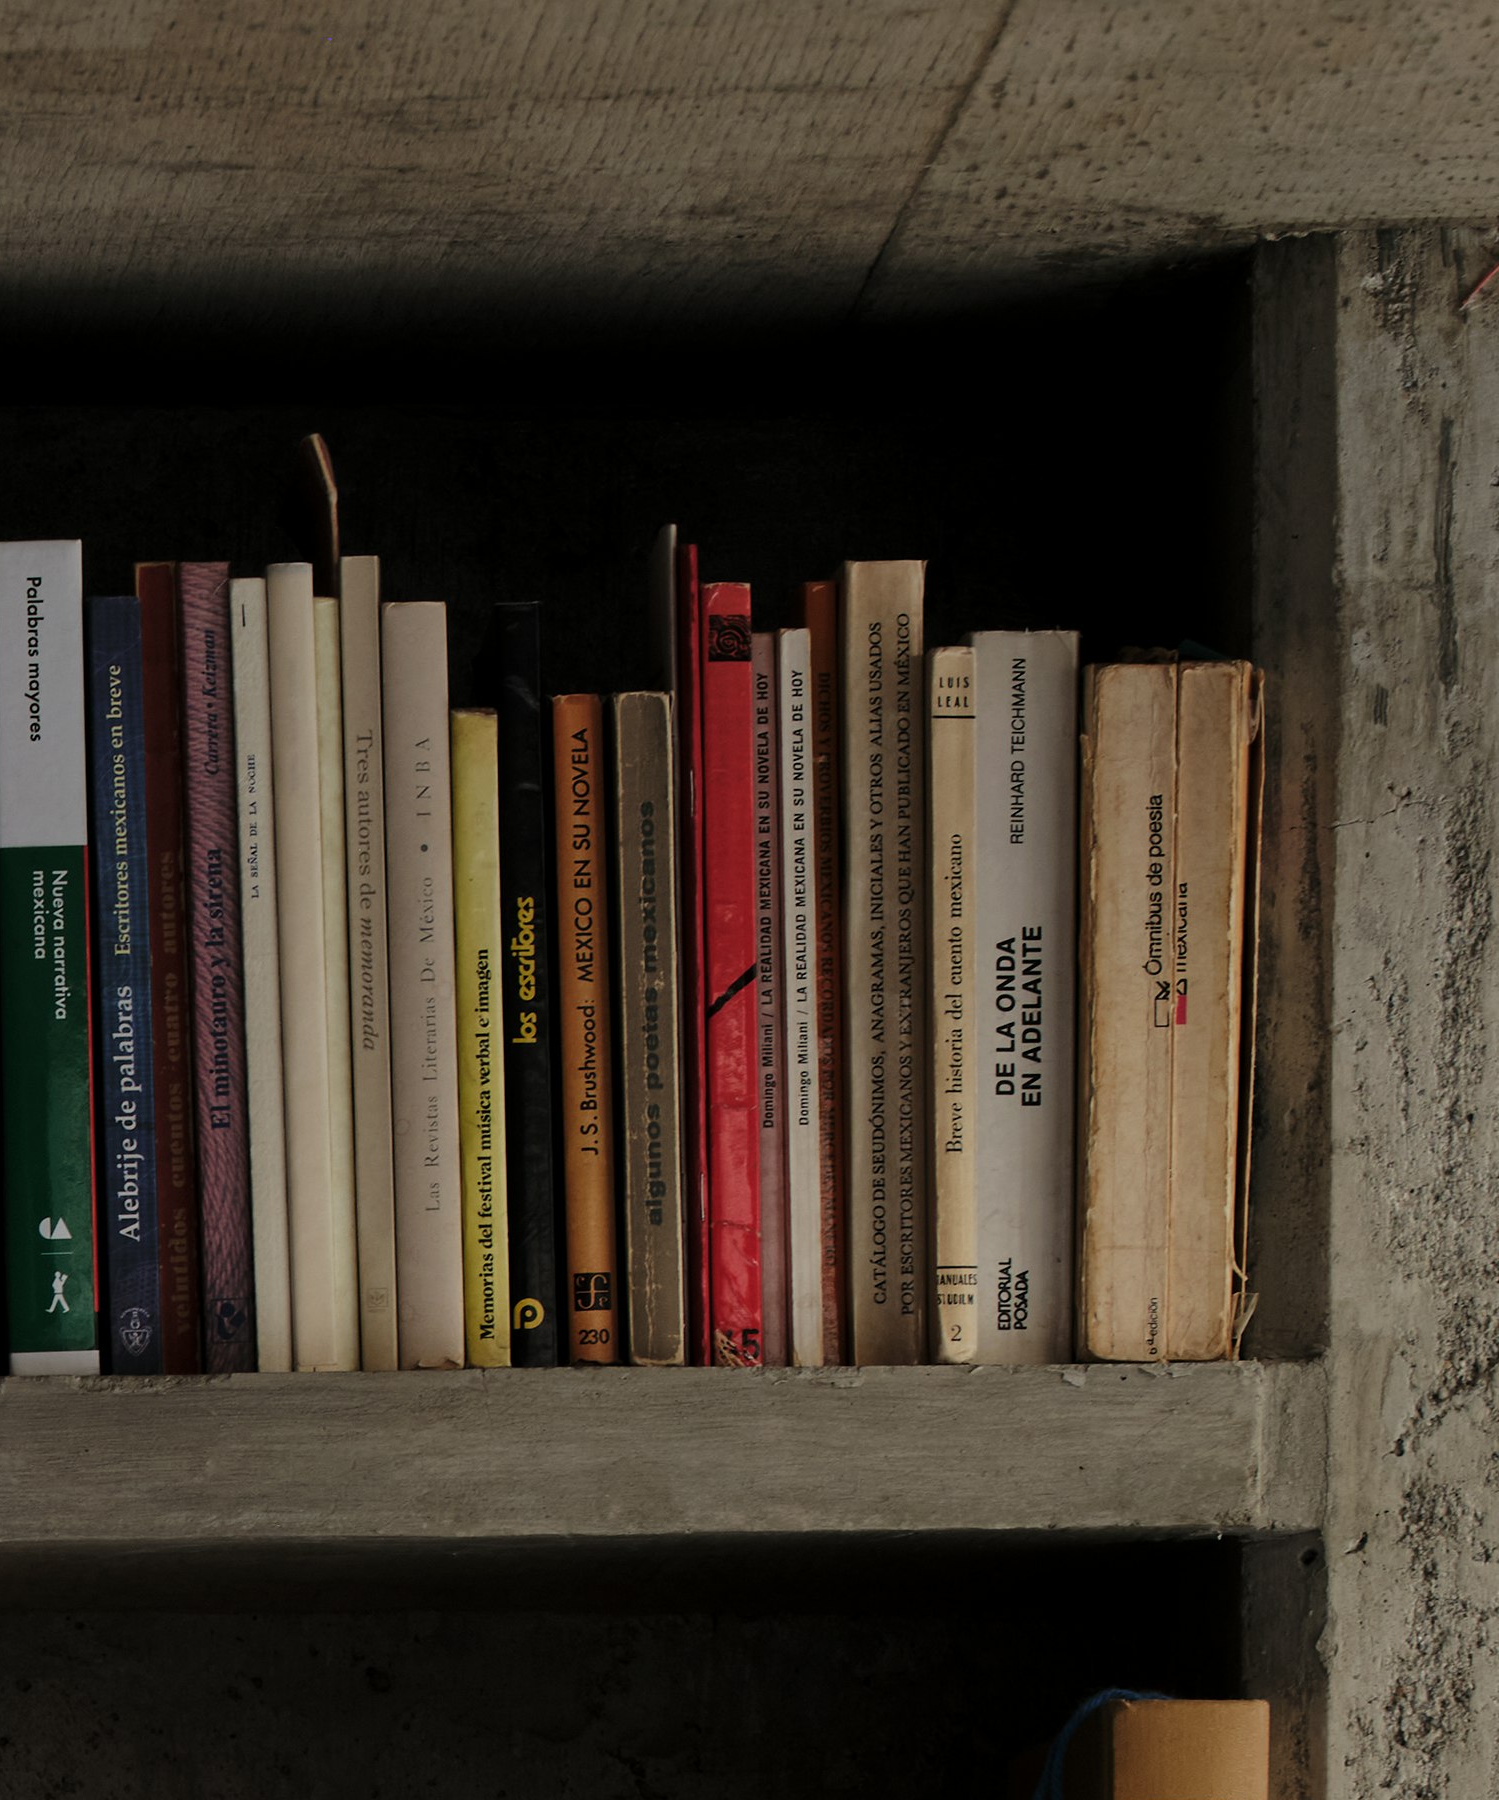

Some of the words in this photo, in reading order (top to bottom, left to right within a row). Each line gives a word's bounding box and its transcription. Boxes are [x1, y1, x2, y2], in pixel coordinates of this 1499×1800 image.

[26, 577, 44, 656] Palabras
[26, 663, 44, 741] mayores
[106, 664, 123, 717] breve
[1012, 658, 1025, 754] TEICHMANN
[109, 724, 123, 748] en
[570, 728, 588, 815] NOVELA
[1010, 760, 1024, 844] REINHARD
[109, 753, 128, 855] mexicanos
[572, 824, 589, 849] SU
[51, 869, 69, 929] Nueva
[574, 860, 590, 888] EN
[32, 869, 50, 958] mexicana
[113, 860, 131, 955] Escritores
[510, 896, 536, 1001] escritores
[574, 898, 593, 982] MEXICO
[53, 936, 70, 1021] narrativa
[475, 949, 493, 1012] imagen
[996, 937, 1015, 1012] ONDA
[1022, 926, 1042, 1063] ADELANTE
[112, 985, 142, 1093] palabras
[476, 1033, 490, 1084] verbal
[512, 1012, 537, 1044] los
[579, 999, 597, 1111] Brushwood:
[996, 1022, 1015, 1053] LA
[996, 1063, 1015, 1095] DE
[1022, 1073, 1041, 1107] EN
[115, 1101, 136, 1130] de
[477, 1090, 491, 1150] música
[581, 1116, 597, 1134] S.
[582, 1140, 598, 1155] J.
[116, 1138, 144, 1242] Alebrije
[477, 1156, 492, 1218] festival
[477, 1223, 492, 1248] del
[479, 1253, 495, 1339] Memorias
[578, 1329, 609, 1344] 230
